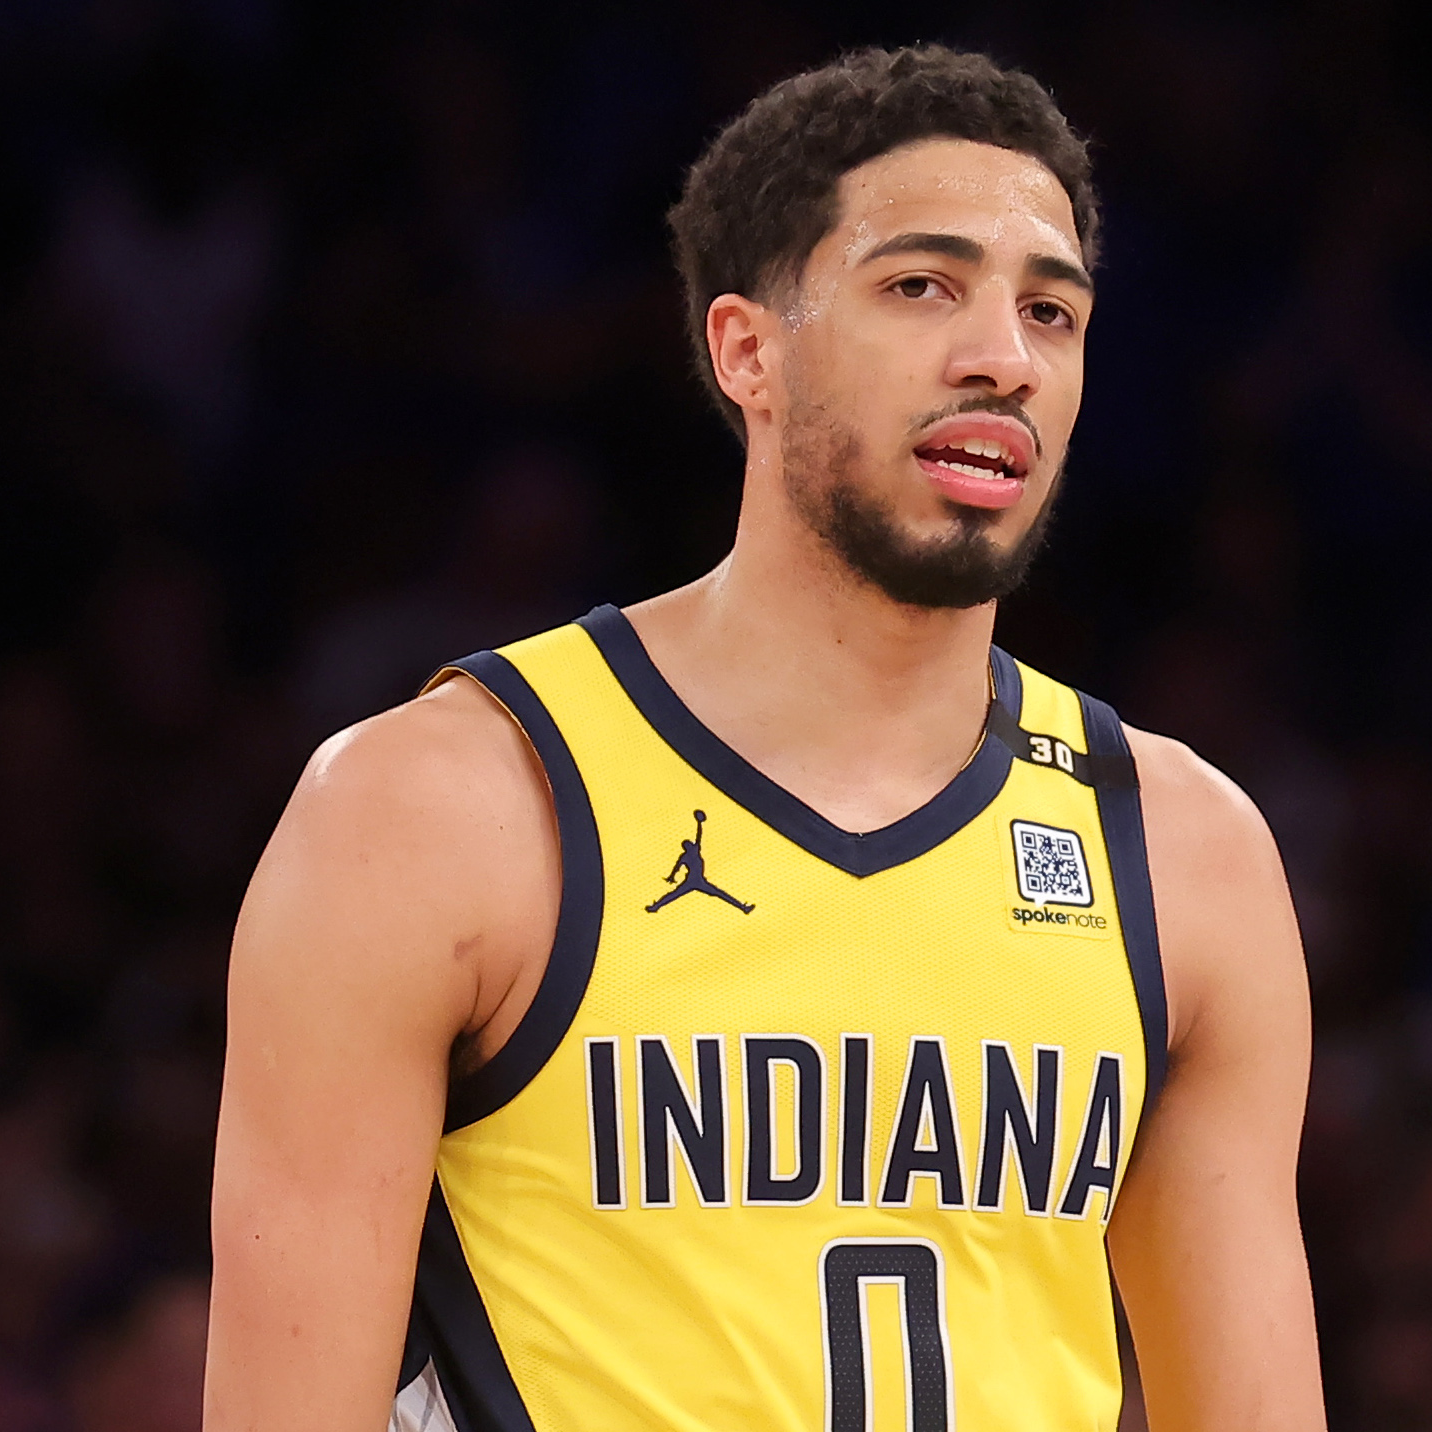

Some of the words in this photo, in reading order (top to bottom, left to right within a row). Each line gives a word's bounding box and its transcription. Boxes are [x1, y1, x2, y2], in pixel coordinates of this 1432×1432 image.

[1028, 735, 1075, 774] 30
[1012, 906, 1107, 929] spokenote
[584, 1032, 1125, 1224] INDIANA
